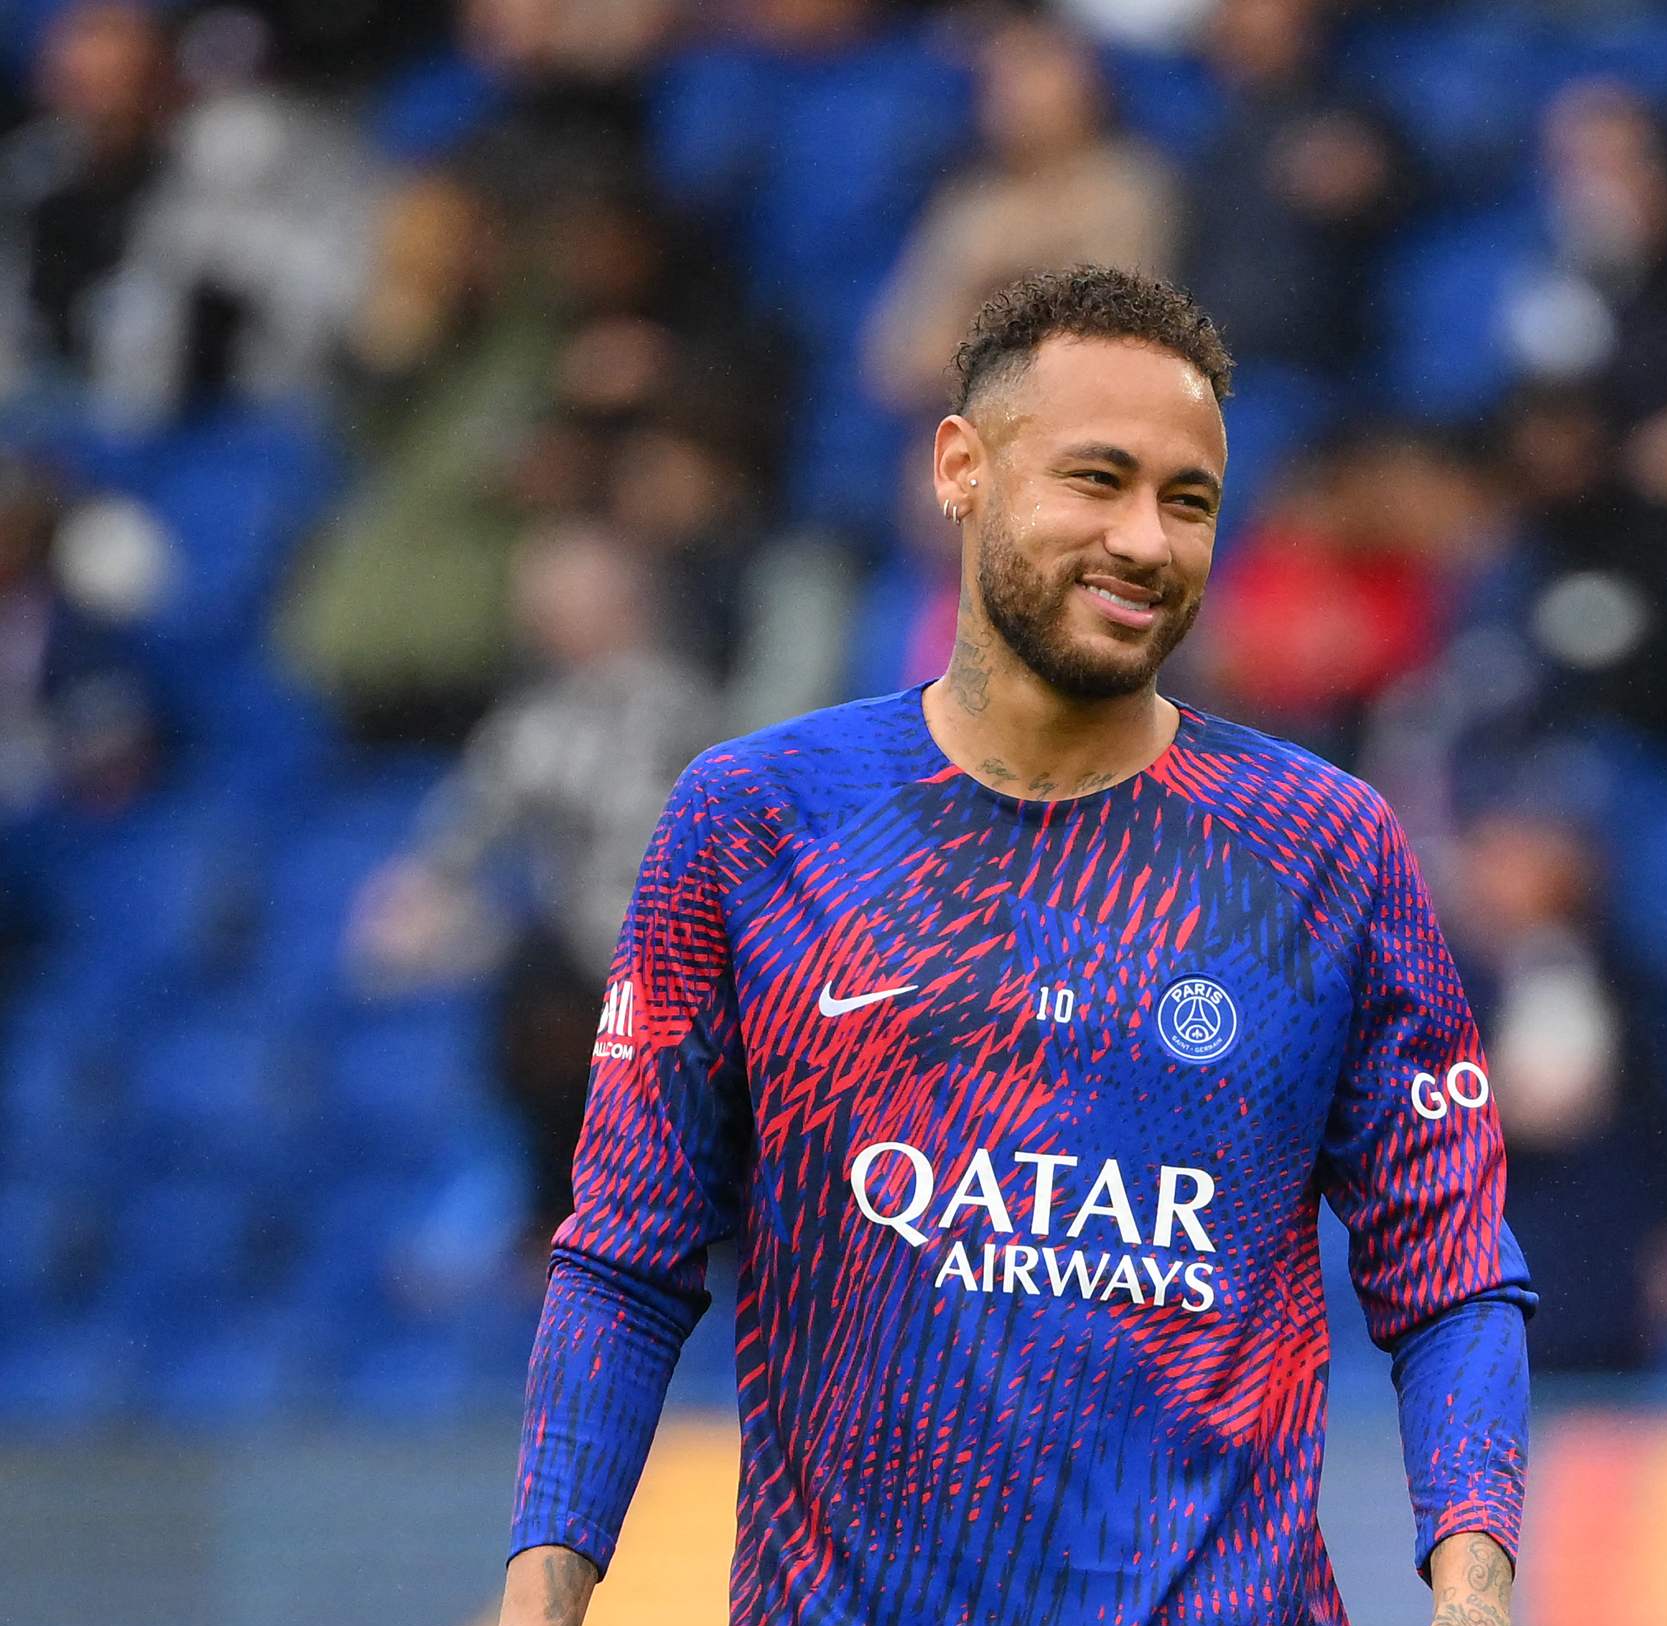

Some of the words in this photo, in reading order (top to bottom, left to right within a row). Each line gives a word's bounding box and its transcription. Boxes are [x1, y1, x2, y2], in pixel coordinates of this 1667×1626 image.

[1036, 986, 1074, 1023] 10
[1170, 983, 1223, 1005] PARIS
[1411, 1061, 1489, 1120] GO
[850, 1141, 1216, 1253] QATAR
[934, 1240, 1215, 1312] AIRWAYS
